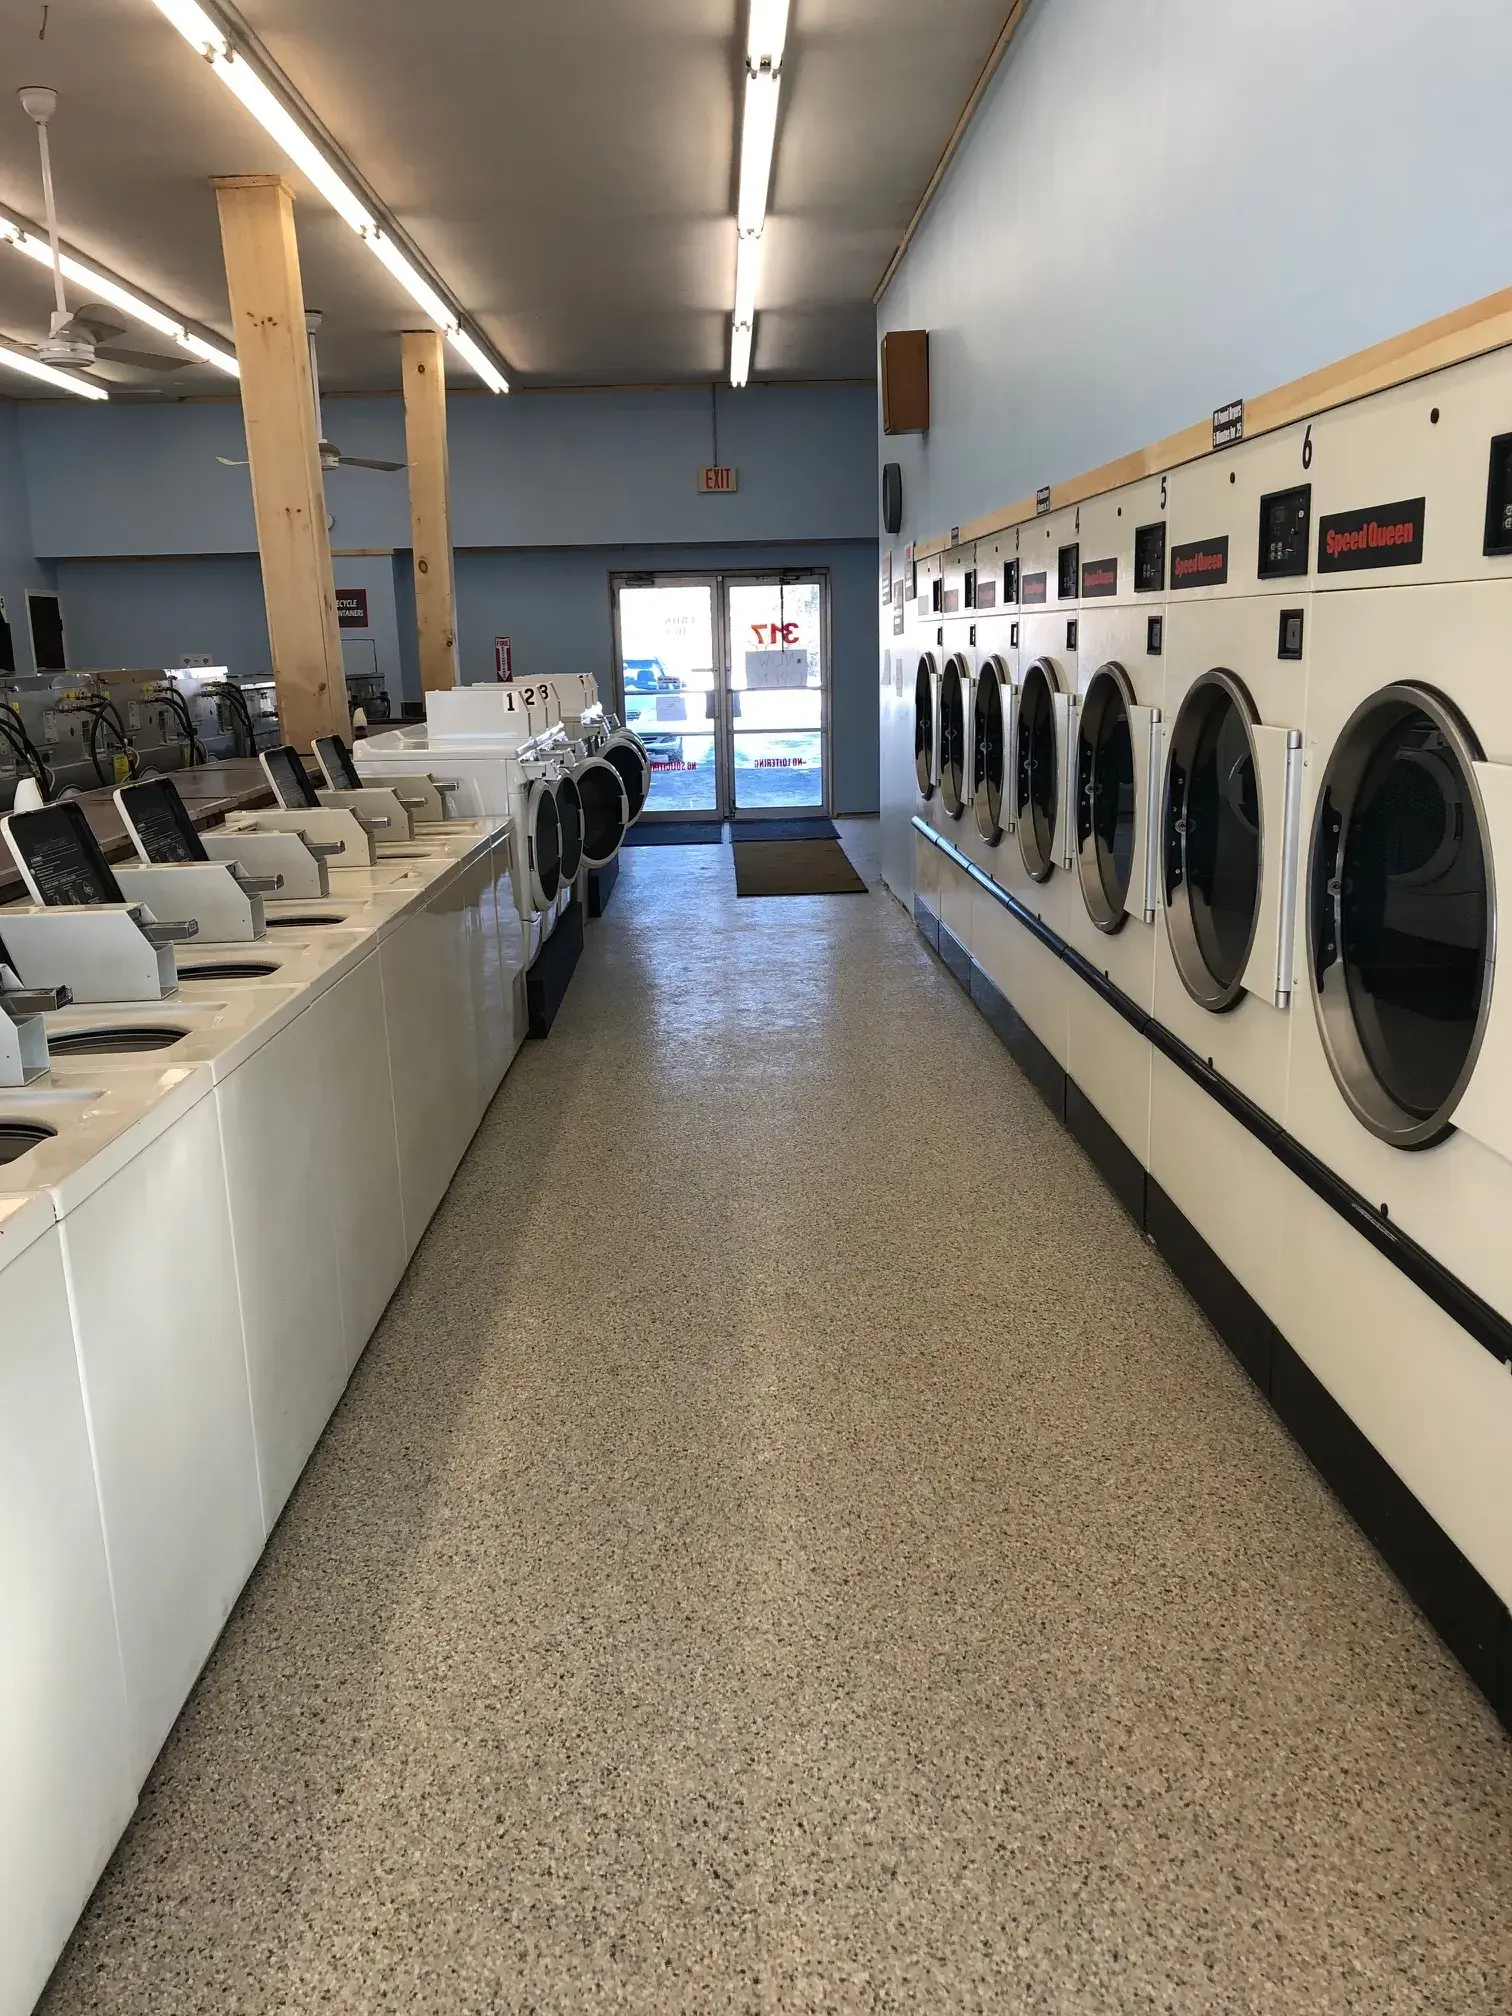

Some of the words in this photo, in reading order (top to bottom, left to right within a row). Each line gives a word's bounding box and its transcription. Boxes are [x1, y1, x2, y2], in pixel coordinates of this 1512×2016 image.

[1303, 424, 1313, 469] 6
[705, 468, 731, 489] EXIT
[1160, 476, 1167, 510] 5
[1074, 507, 1080, 534] 4
[1326, 523, 1368, 558] Speed
[1368, 521, 1413, 547] Queen
[1175, 553, 1198, 578] Speed
[1198, 552, 1222, 571] Queen
[335, 599, 357, 607] ECYCLE
[337, 609, 364, 617] NTAINERS
[506, 692, 515, 711] 1
[524, 688, 535, 706] 2
[539, 684, 549, 700] 3
